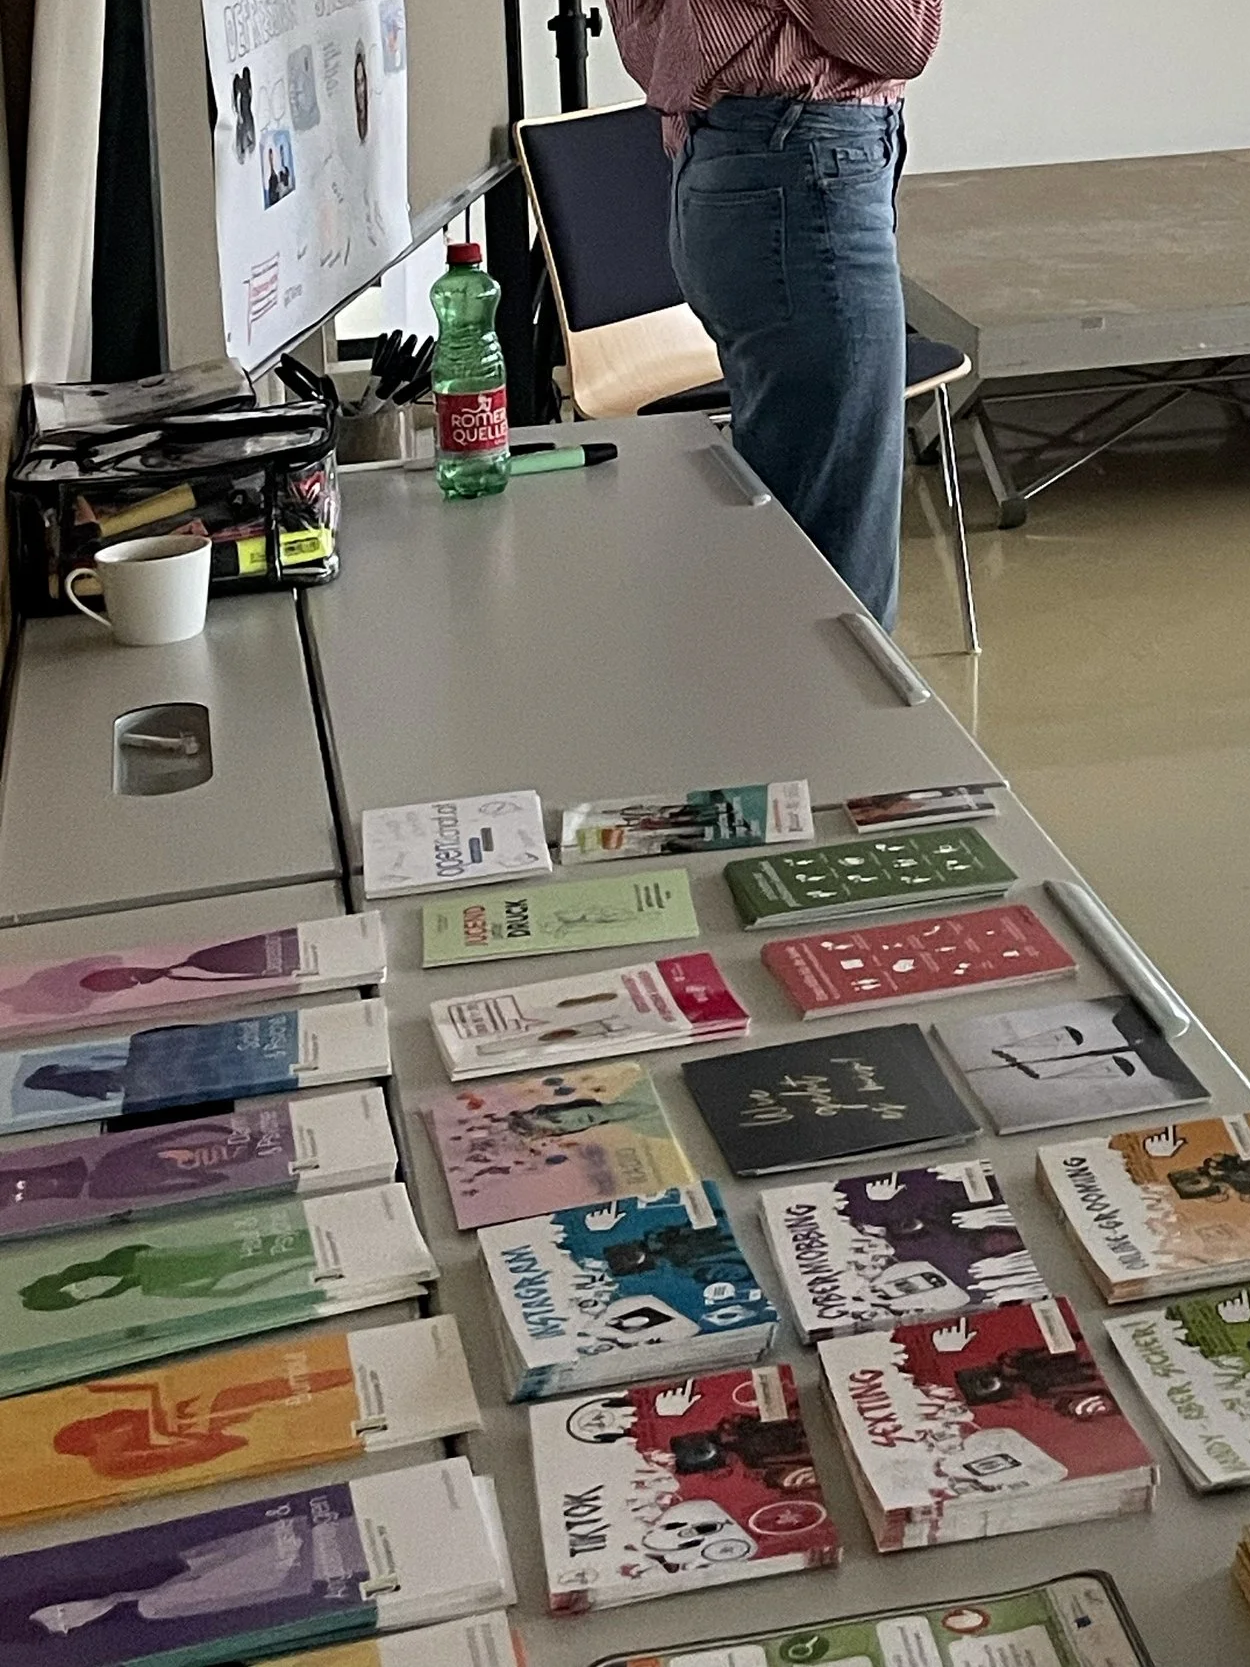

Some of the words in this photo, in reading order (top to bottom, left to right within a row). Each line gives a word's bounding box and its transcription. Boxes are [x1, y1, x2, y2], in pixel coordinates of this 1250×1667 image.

[453, 421, 508, 445] QUELLE
[462, 905, 489, 947] JUGEND
[505, 898, 531, 939] DRUCK
[739, 1089, 794, 1128] Wie
[778, 1074, 868, 1117] geht
[1060, 1157, 1147, 1273] ONLINE-GROOMING
[784, 1202, 846, 1321] CYBERMOBBING
[500, 1244, 563, 1342] INSTAGRAM
[1120, 1320, 1187, 1380] SICHER!
[848, 1368, 916, 1449] SEXTING
[562, 1484, 604, 1559] TIKTOK
